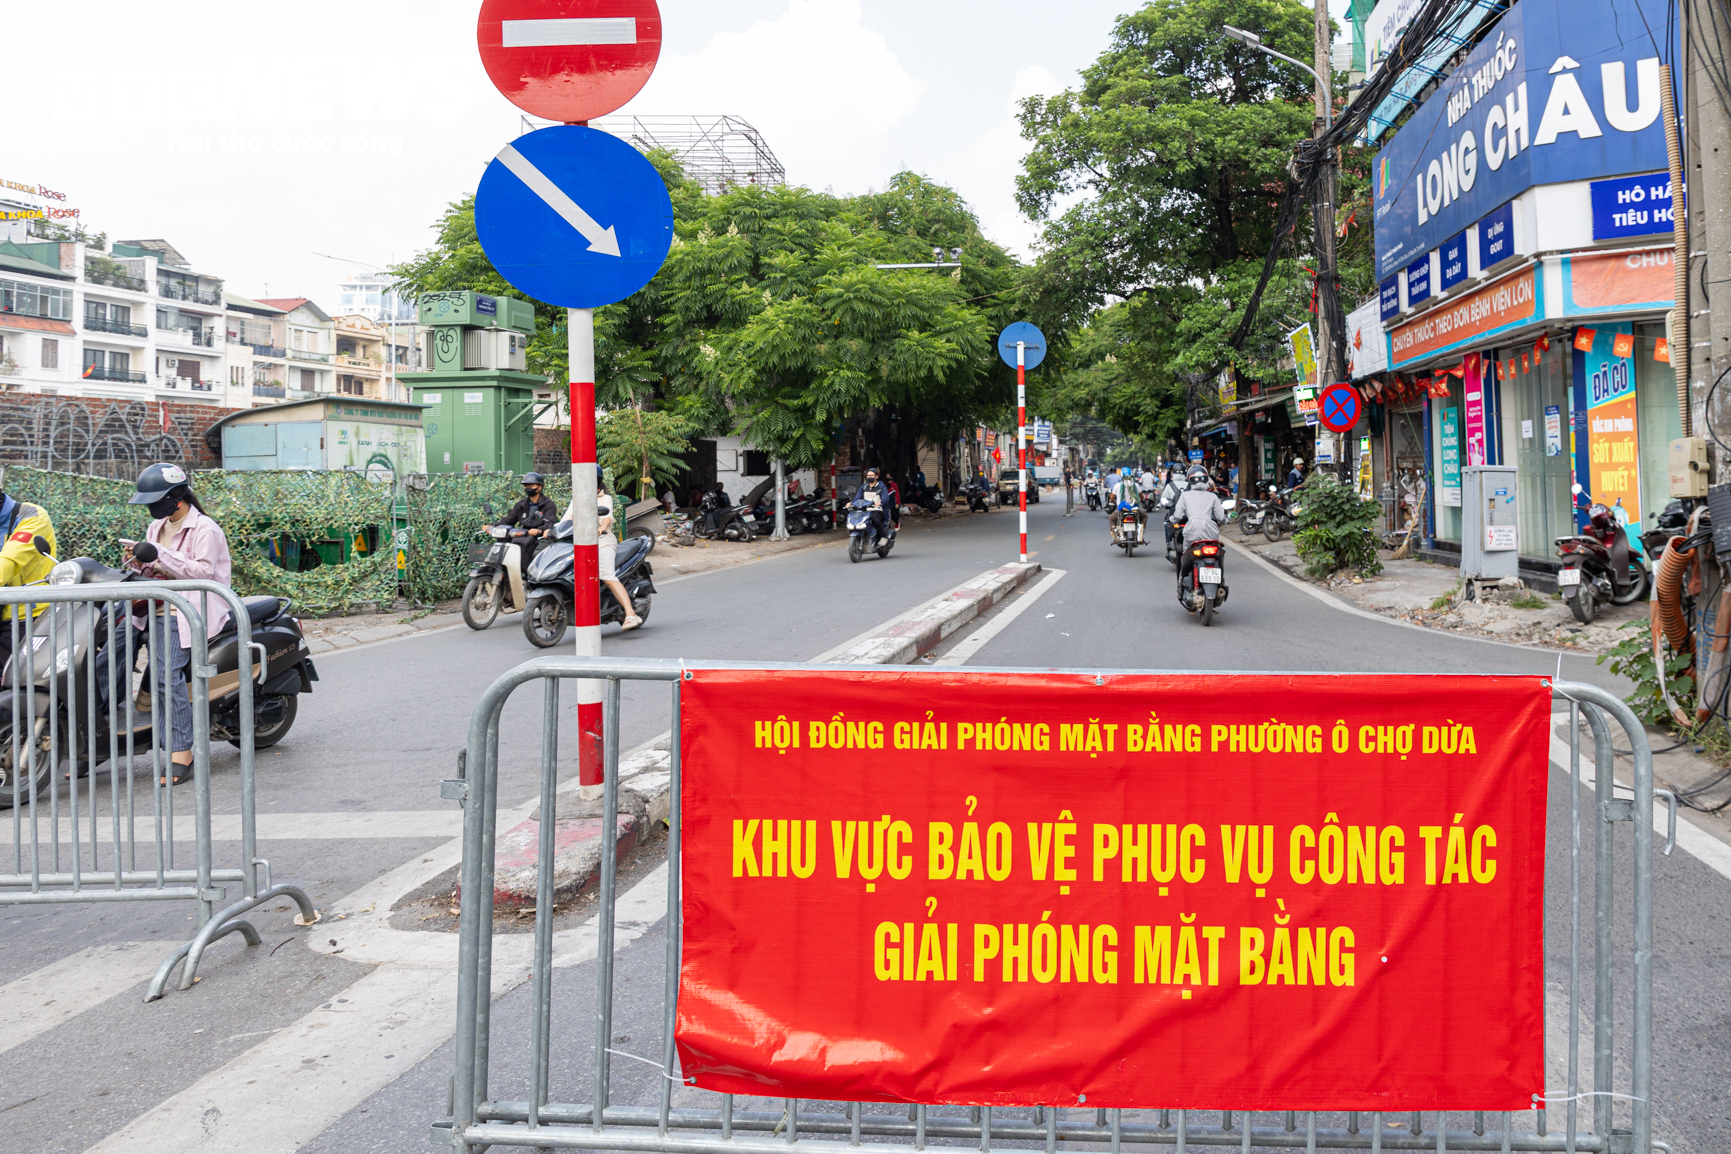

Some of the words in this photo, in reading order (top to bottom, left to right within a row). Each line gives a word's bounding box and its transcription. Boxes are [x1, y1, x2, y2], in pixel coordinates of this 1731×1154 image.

[1447, 77, 1472, 128] NHÀ
[1472, 30, 1517, 103] THUỐC
[1416, 129, 1477, 226] LONG
[1484, 55, 1663, 172] CHÂU
[7, 181, 36, 194] KHOA
[38, 184, 66, 202] Rose
[1617, 185, 1646, 204] HÔ
[8, 210, 44, 220] KHOA
[46, 205, 80, 219] Rose
[1612, 209, 1648, 227] TIÊU
[1653, 204, 1687, 223] HÓ
[1448, 247, 1459, 261] GAN
[1490, 239, 1503, 255] GOUT
[1446, 268, 1453, 280] DẠ
[1452, 262, 1462, 277] DÀY
[1393, 328, 1414, 353] CHUYÊN
[1413, 317, 1435, 343] THUỐC
[1435, 314, 1453, 335] THEO
[1453, 308, 1470, 329] ĐƠN
[1470, 297, 1491, 326] BỆNH
[1491, 285, 1512, 317] VIỆN
[1512, 276, 1532, 306] LỚN
[1592, 361, 1610, 404] ĐÃ
[1611, 357, 1629, 395] CÓ
[1614, 415, 1634, 432] PHÒNG
[1443, 449, 1458, 460] LONG
[1593, 437, 1610, 464] SỐT
[1611, 437, 1635, 463] XUẤT
[1443, 461, 1458, 474] CHÂU
[1601, 465, 1629, 492] HUYẾT
[266, 648, 288, 665] Fashion
[288, 643, 296, 652] 125
[755, 715, 799, 754] HỘI
[809, 712, 884, 749] ĐỒNG
[894, 711, 947, 749] GIẢI
[957, 717, 1049, 751] PHÓNG
[1060, 718, 1118, 758] MẶT
[1127, 711, 1201, 752] BẰNG
[1211, 718, 1322, 753] PHƯỜNG
[1332, 719, 1349, 753] Ô
[1359, 724, 1415, 760] CHỢ
[1422, 719, 1476, 754] DỪA
[733, 819, 816, 878] KHU
[831, 815, 912, 892] VỰC
[929, 795, 1012, 881] BẢO
[1027, 810, 1077, 895] VỆ
[1093, 824, 1205, 896] PHỤC
[1221, 825, 1273, 897] VỤ
[1290, 812, 1404, 885] CÔNG
[1419, 813, 1496, 885] TÁC
[874, 896, 958, 981] GIẢI
[974, 911, 1118, 984] PHÓNG
[1134, 912, 1225, 999] MẶT
[1240, 899, 1355, 986] BẰNG
